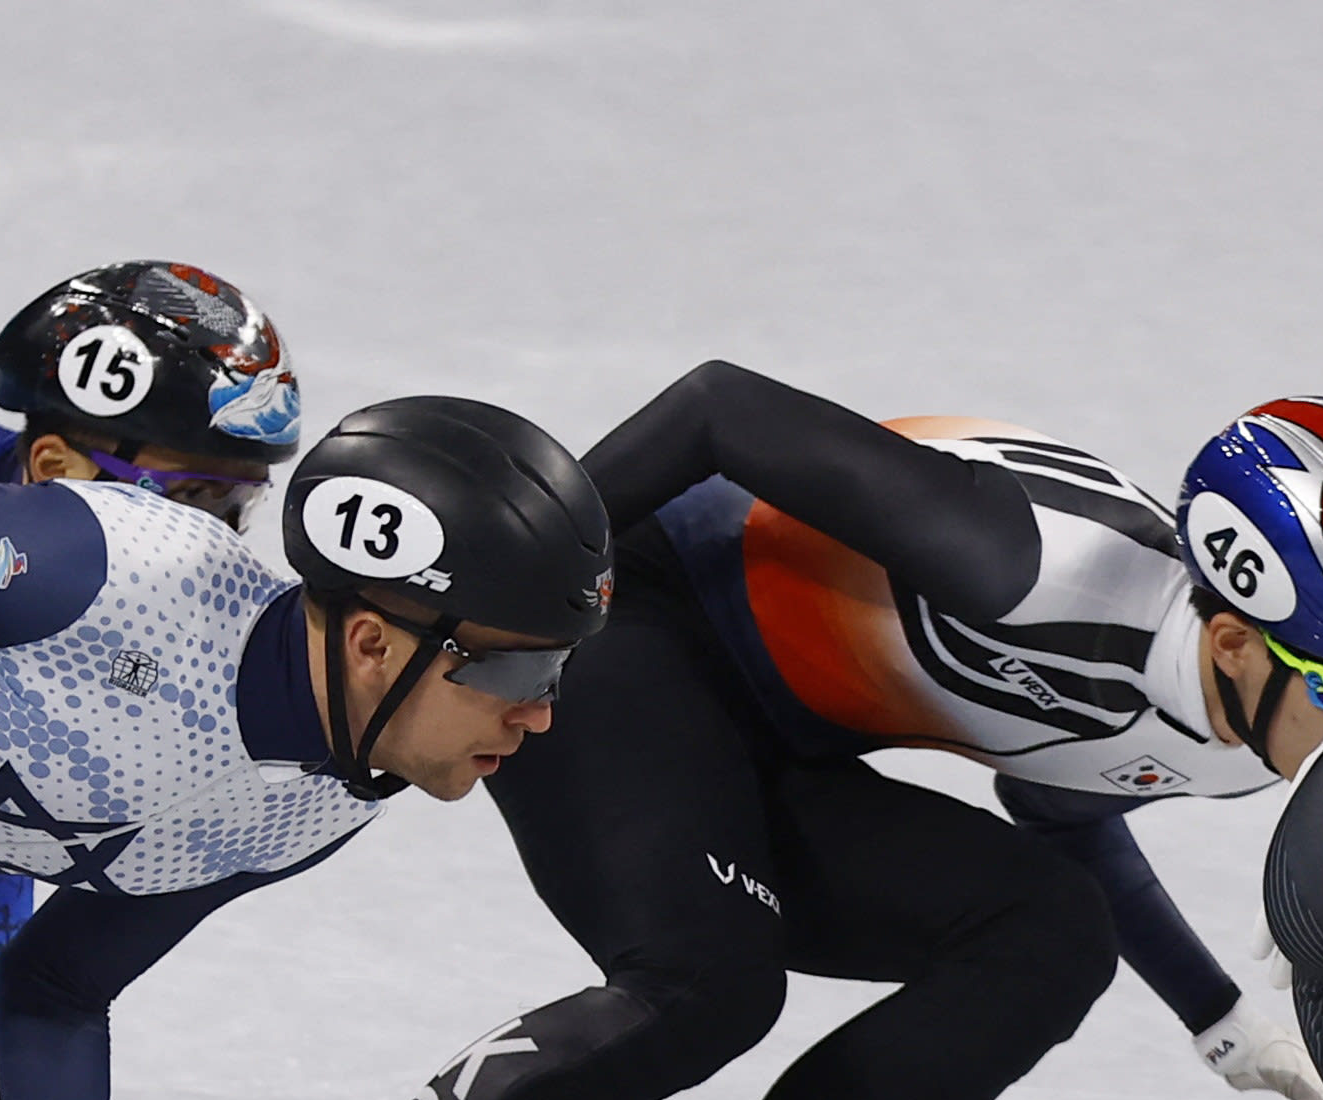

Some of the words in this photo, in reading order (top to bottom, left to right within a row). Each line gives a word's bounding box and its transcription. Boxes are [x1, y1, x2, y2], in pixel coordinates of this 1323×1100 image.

[75, 338, 141, 401] 15
[335, 493, 403, 560] 13
[1203, 527, 1265, 598] 46
